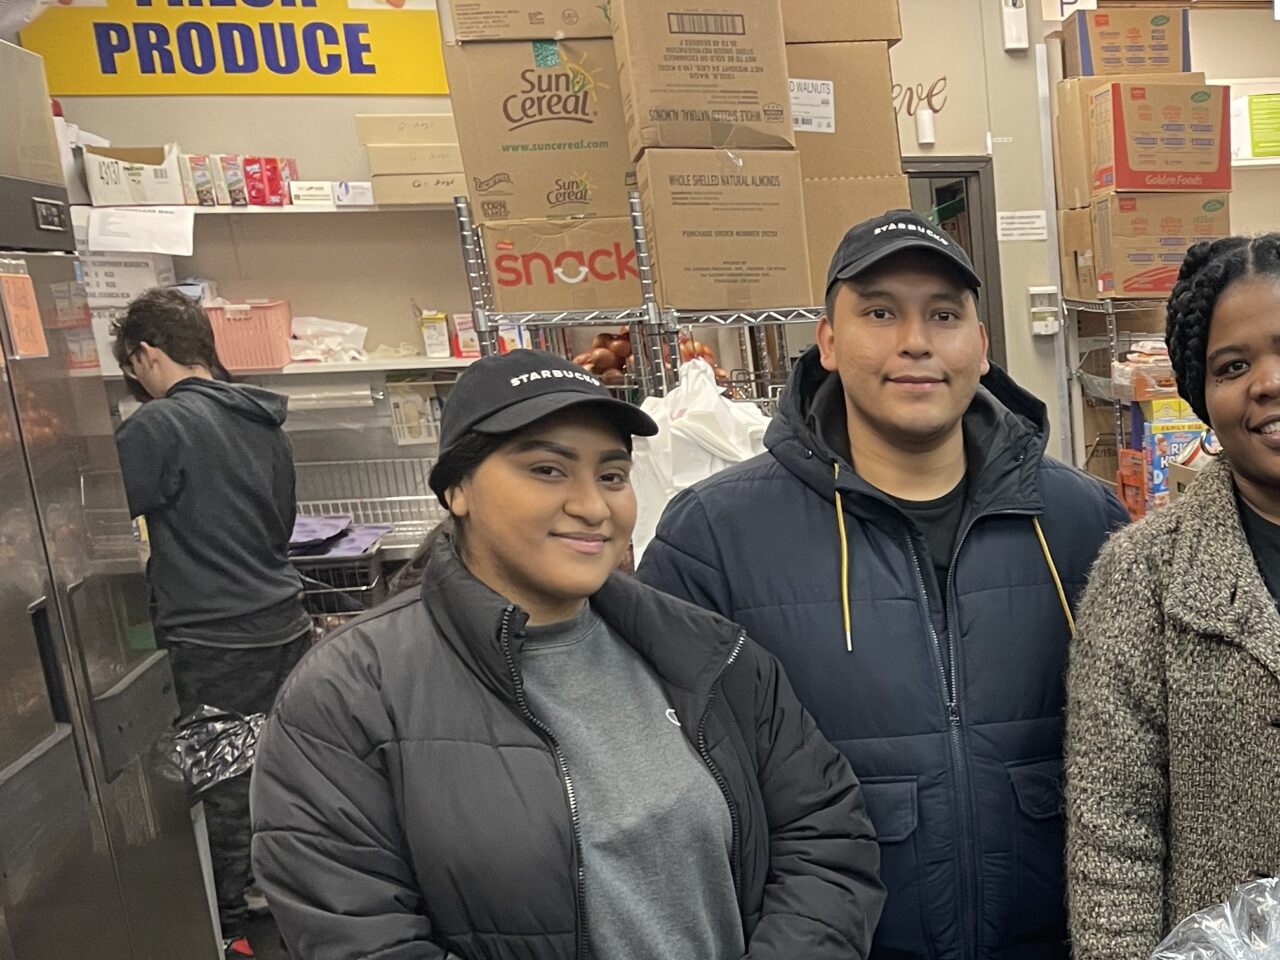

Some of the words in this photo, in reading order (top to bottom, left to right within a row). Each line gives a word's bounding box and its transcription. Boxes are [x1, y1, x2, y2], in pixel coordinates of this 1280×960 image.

[93, 21, 377, 75] PRODUCE
[520, 69, 571, 94] Sun
[796, 81, 831, 94] WALNUTS
[502, 90, 590, 123] Cereal
[501, 139, 609, 152] www.suncereal.com
[554, 178, 580, 191] Sun
[668, 174, 691, 187] WHOLE
[692, 175, 720, 187] SHELLED
[720, 175, 750, 187] NATURAL
[751, 175, 781, 187] ALMONDS
[546, 188, 589, 205] Cereal
[873, 222, 949, 246] STARBUCKS
[494, 242, 641, 287] snack
[510, 369, 600, 387] STARBUCKS
